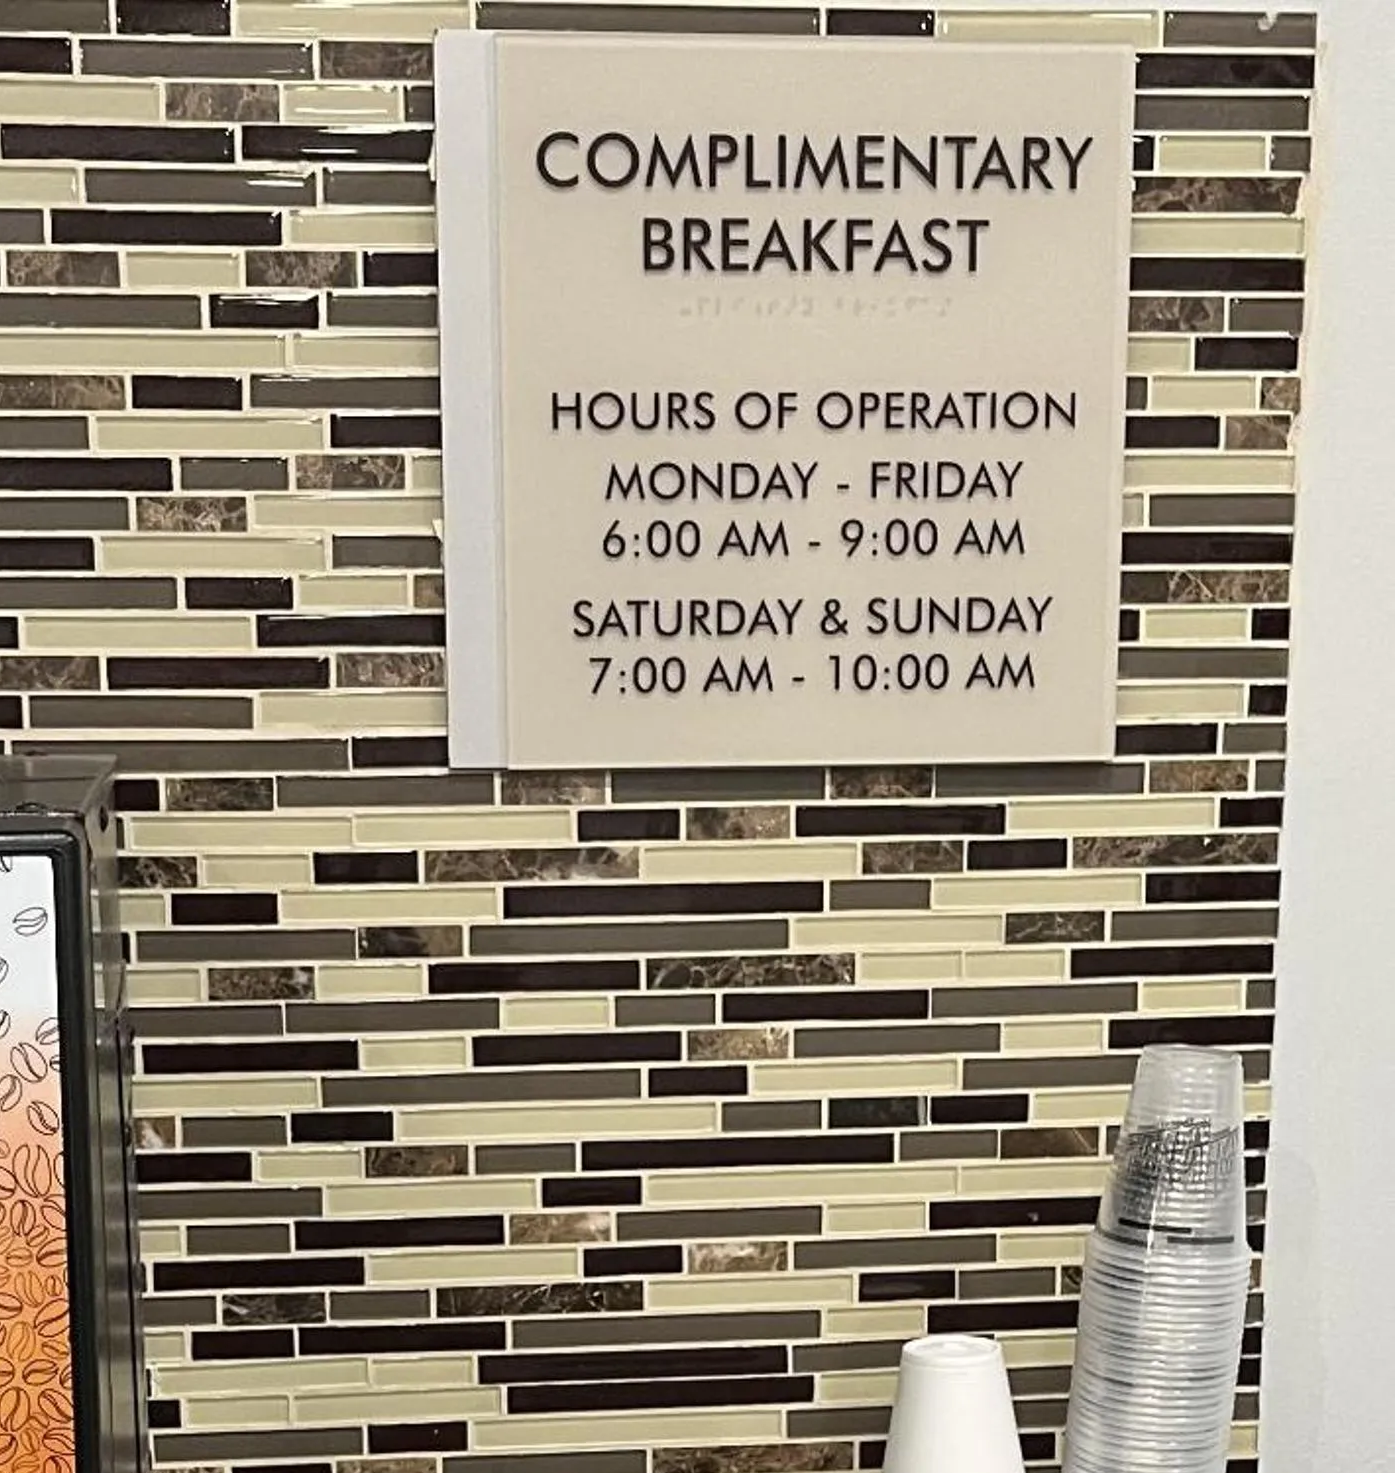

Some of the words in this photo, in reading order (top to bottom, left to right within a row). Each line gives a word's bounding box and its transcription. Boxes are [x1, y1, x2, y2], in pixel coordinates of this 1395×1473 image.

[536, 131, 1093, 191] COMPLIMENTARY
[643, 218, 990, 273] BREAKFAST
[551, 392, 715, 431] HOURS
[734, 392, 798, 430] OF
[816, 392, 1077, 431] OPERATION
[606, 462, 818, 500] MONDAY
[870, 460, 1023, 498] FRIDAY
[603, 520, 701, 559] 6:00
[717, 521, 789, 557] AM
[840, 518, 938, 558] 9:00
[954, 519, 1025, 556] AM
[572, 598, 803, 638] SATURDAY
[820, 599, 849, 635] &
[866, 595, 1053, 635] SUNDAY
[589, 656, 687, 695] 7:00
[702, 657, 774, 694] AM
[829, 653, 950, 692] 10:00
[965, 653, 1035, 690] AM
